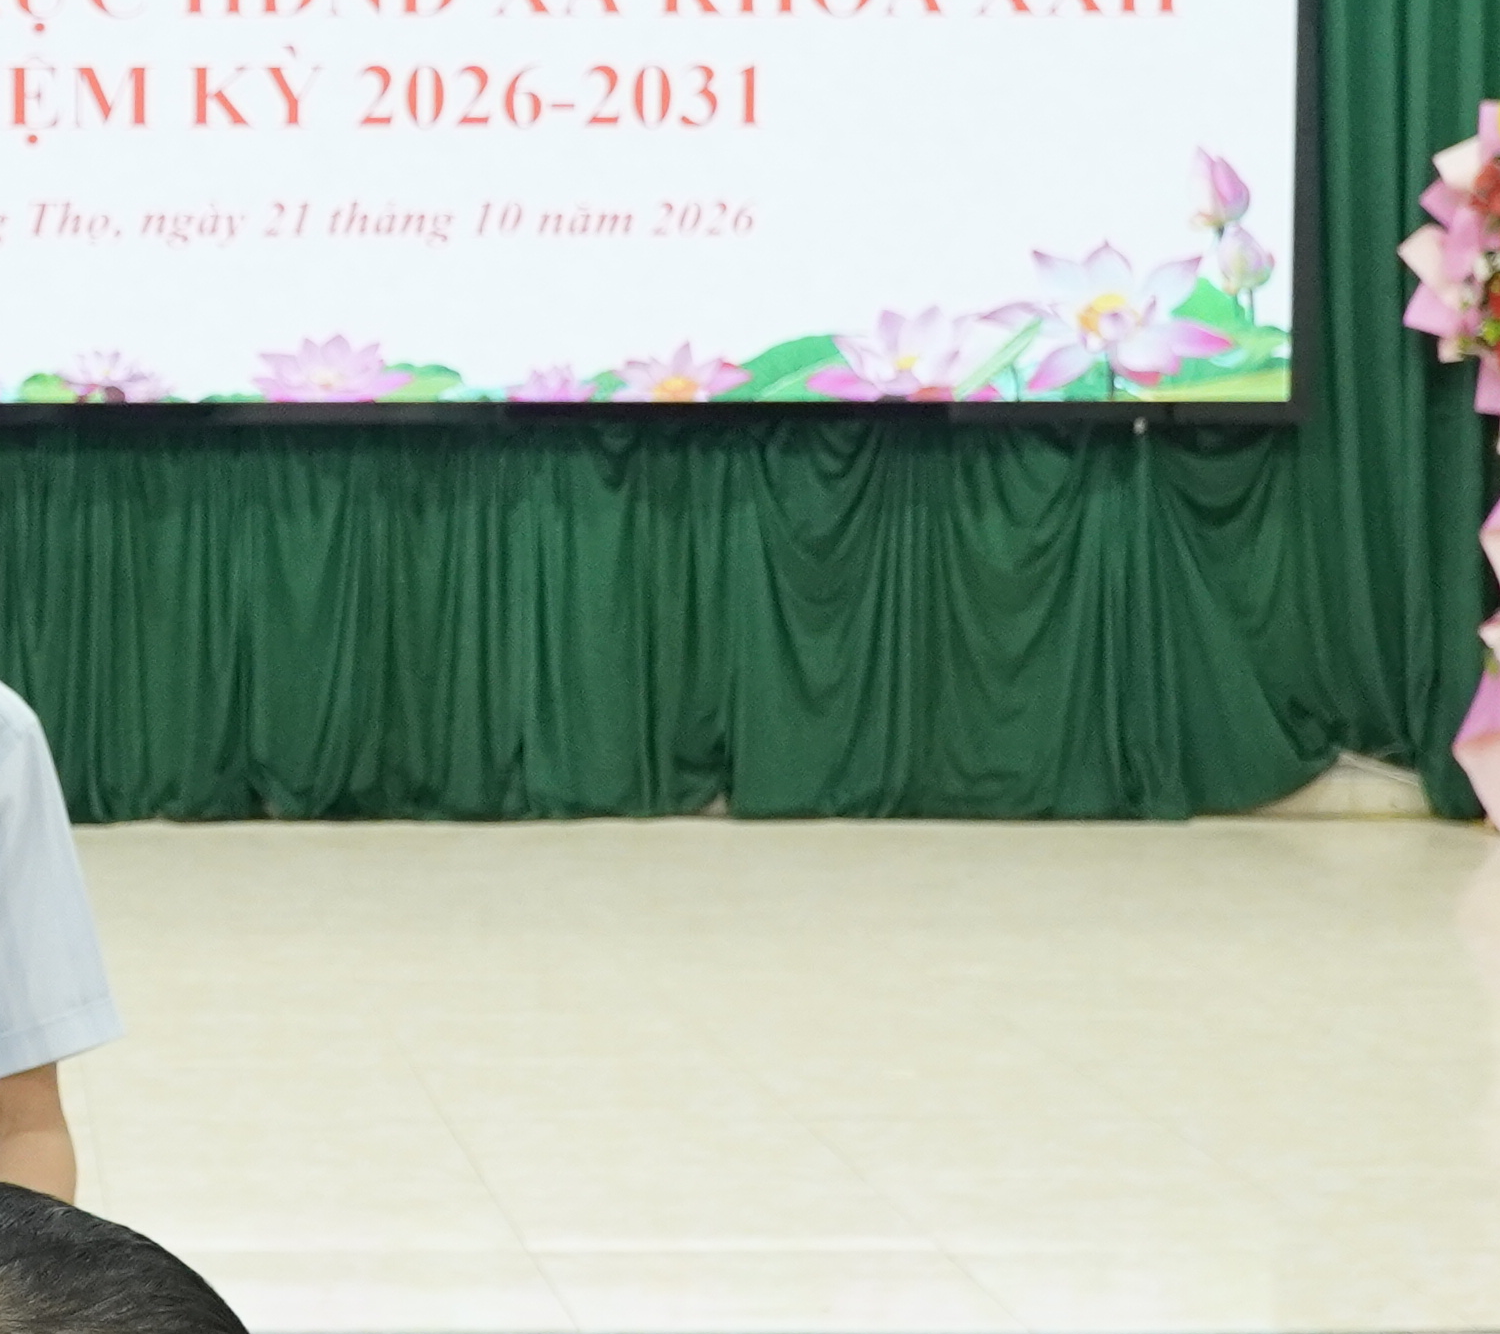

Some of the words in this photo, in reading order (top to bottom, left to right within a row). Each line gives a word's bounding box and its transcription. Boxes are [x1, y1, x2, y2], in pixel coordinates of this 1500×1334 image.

[192, 46, 322, 128] KỲ
[356, 63, 764, 128] 2026-2031
[30, 202, 124, 243] Thọ,
[139, 203, 246, 246] ngày
[264, 202, 312, 238] 21
[474, 201, 524, 238] 10
[536, 203, 634, 238] năm
[652, 202, 756, 238] 2026
